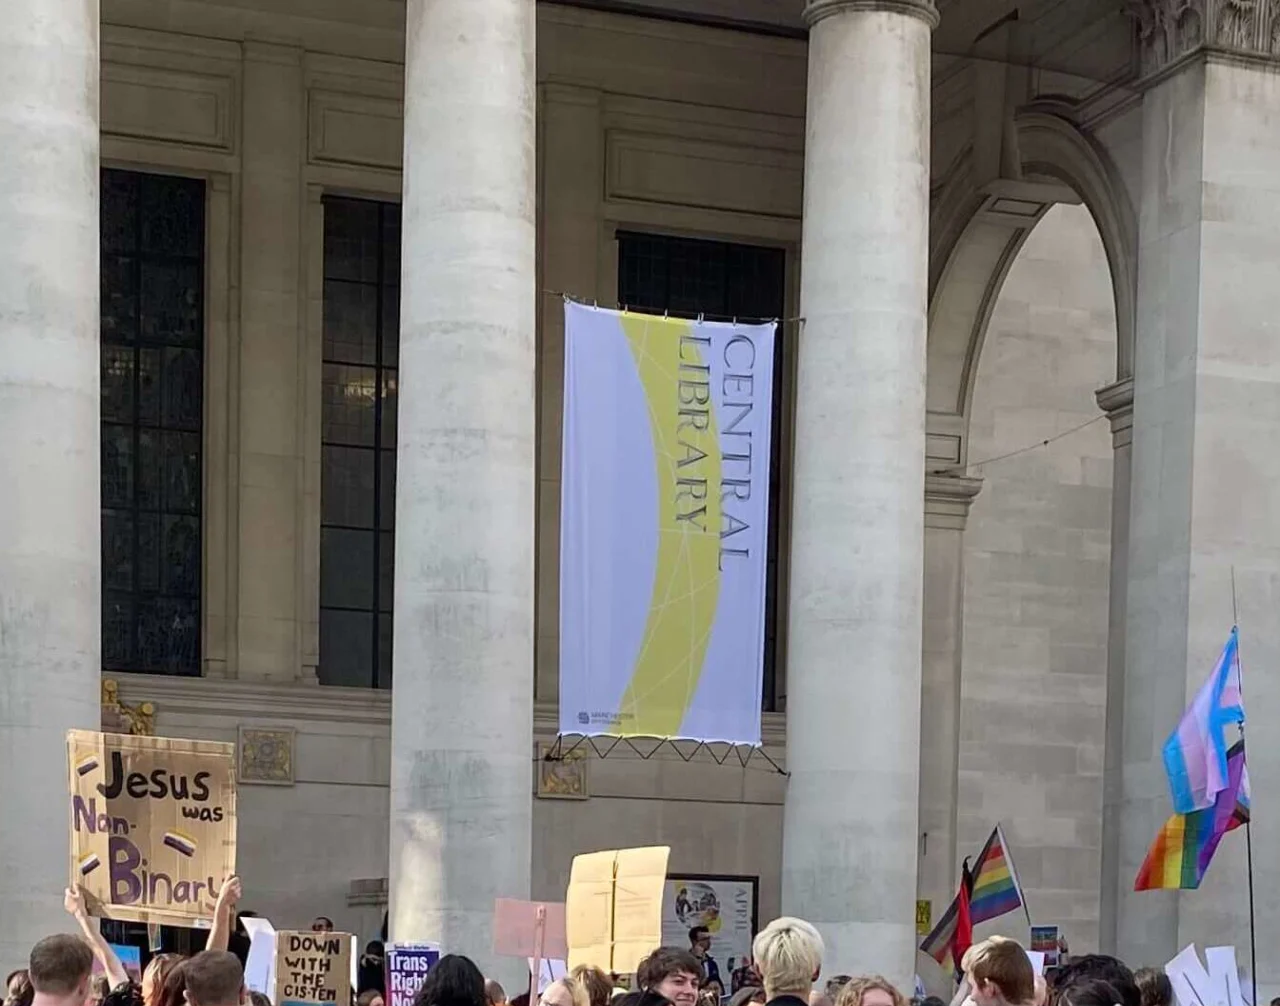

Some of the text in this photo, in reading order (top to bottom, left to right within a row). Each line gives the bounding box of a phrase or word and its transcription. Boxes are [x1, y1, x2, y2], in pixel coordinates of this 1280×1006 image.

[675, 336, 711, 532] LIBRARY
[717, 334, 756, 572] CENTRAL
[96, 751, 210, 801] Jesus
[73, 795, 136, 834] Non-
[182, 805, 223, 822] was
[735, 887, 748, 930] APRIL
[290, 936, 340, 954] DOWN
[285, 957, 331, 971] WITH
[388, 951, 428, 971] Trans
[291, 972, 325, 988] THE
